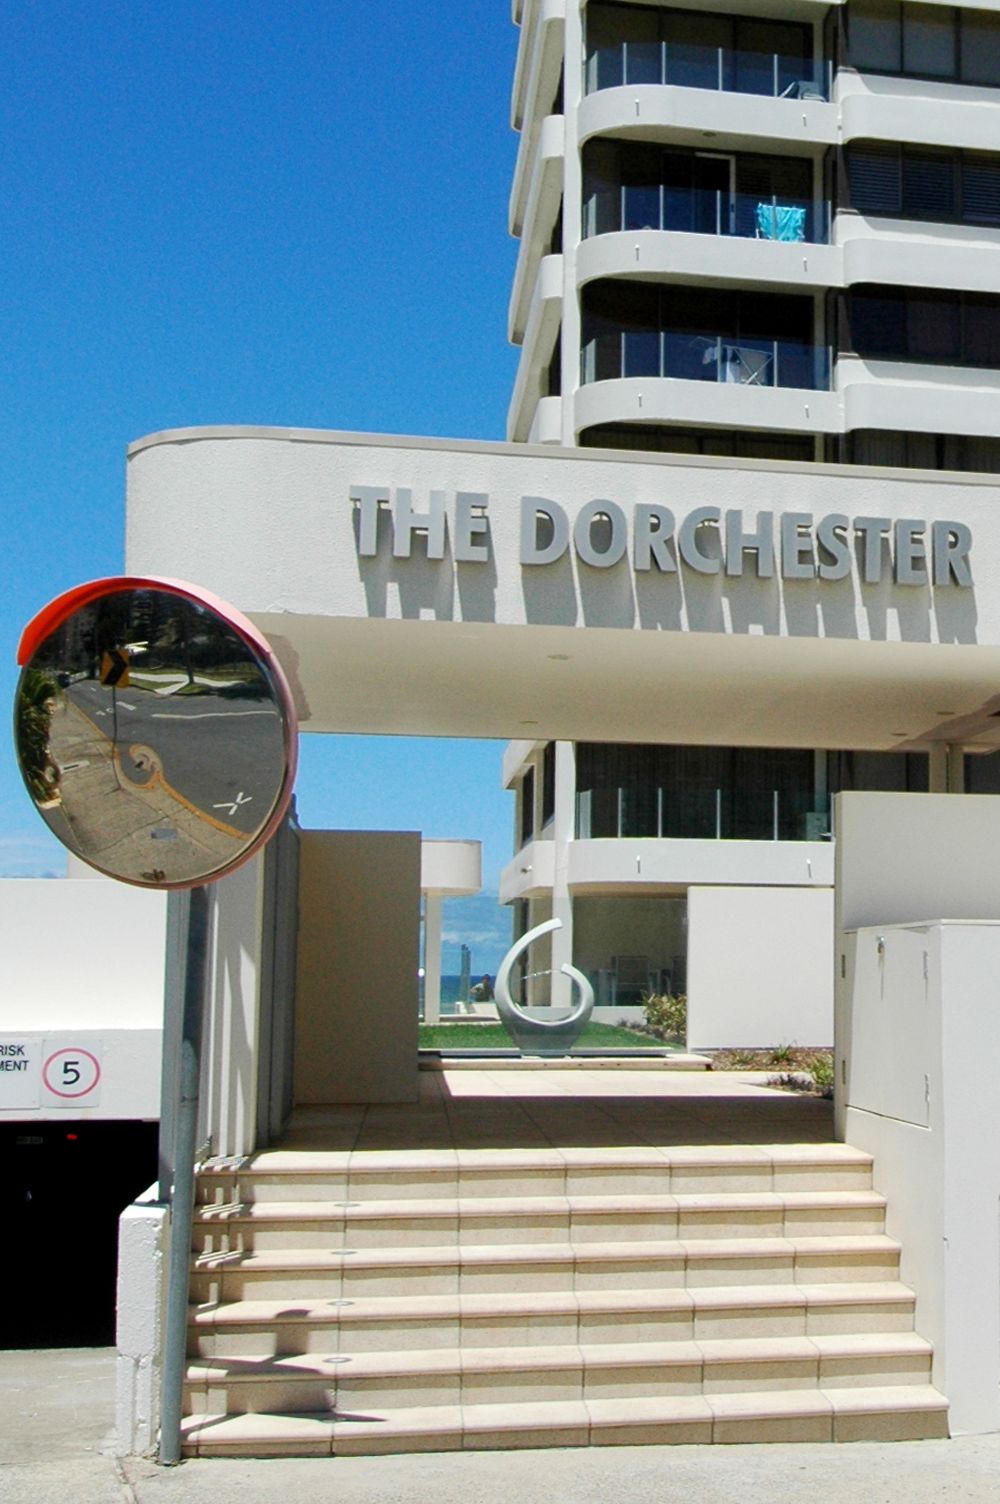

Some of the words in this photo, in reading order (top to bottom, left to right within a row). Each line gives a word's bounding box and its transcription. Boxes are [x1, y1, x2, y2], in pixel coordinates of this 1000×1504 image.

[350, 485, 489, 562] THE
[520, 496, 975, 587] DORCHESTER
[62, 1061, 81, 1085] 5
